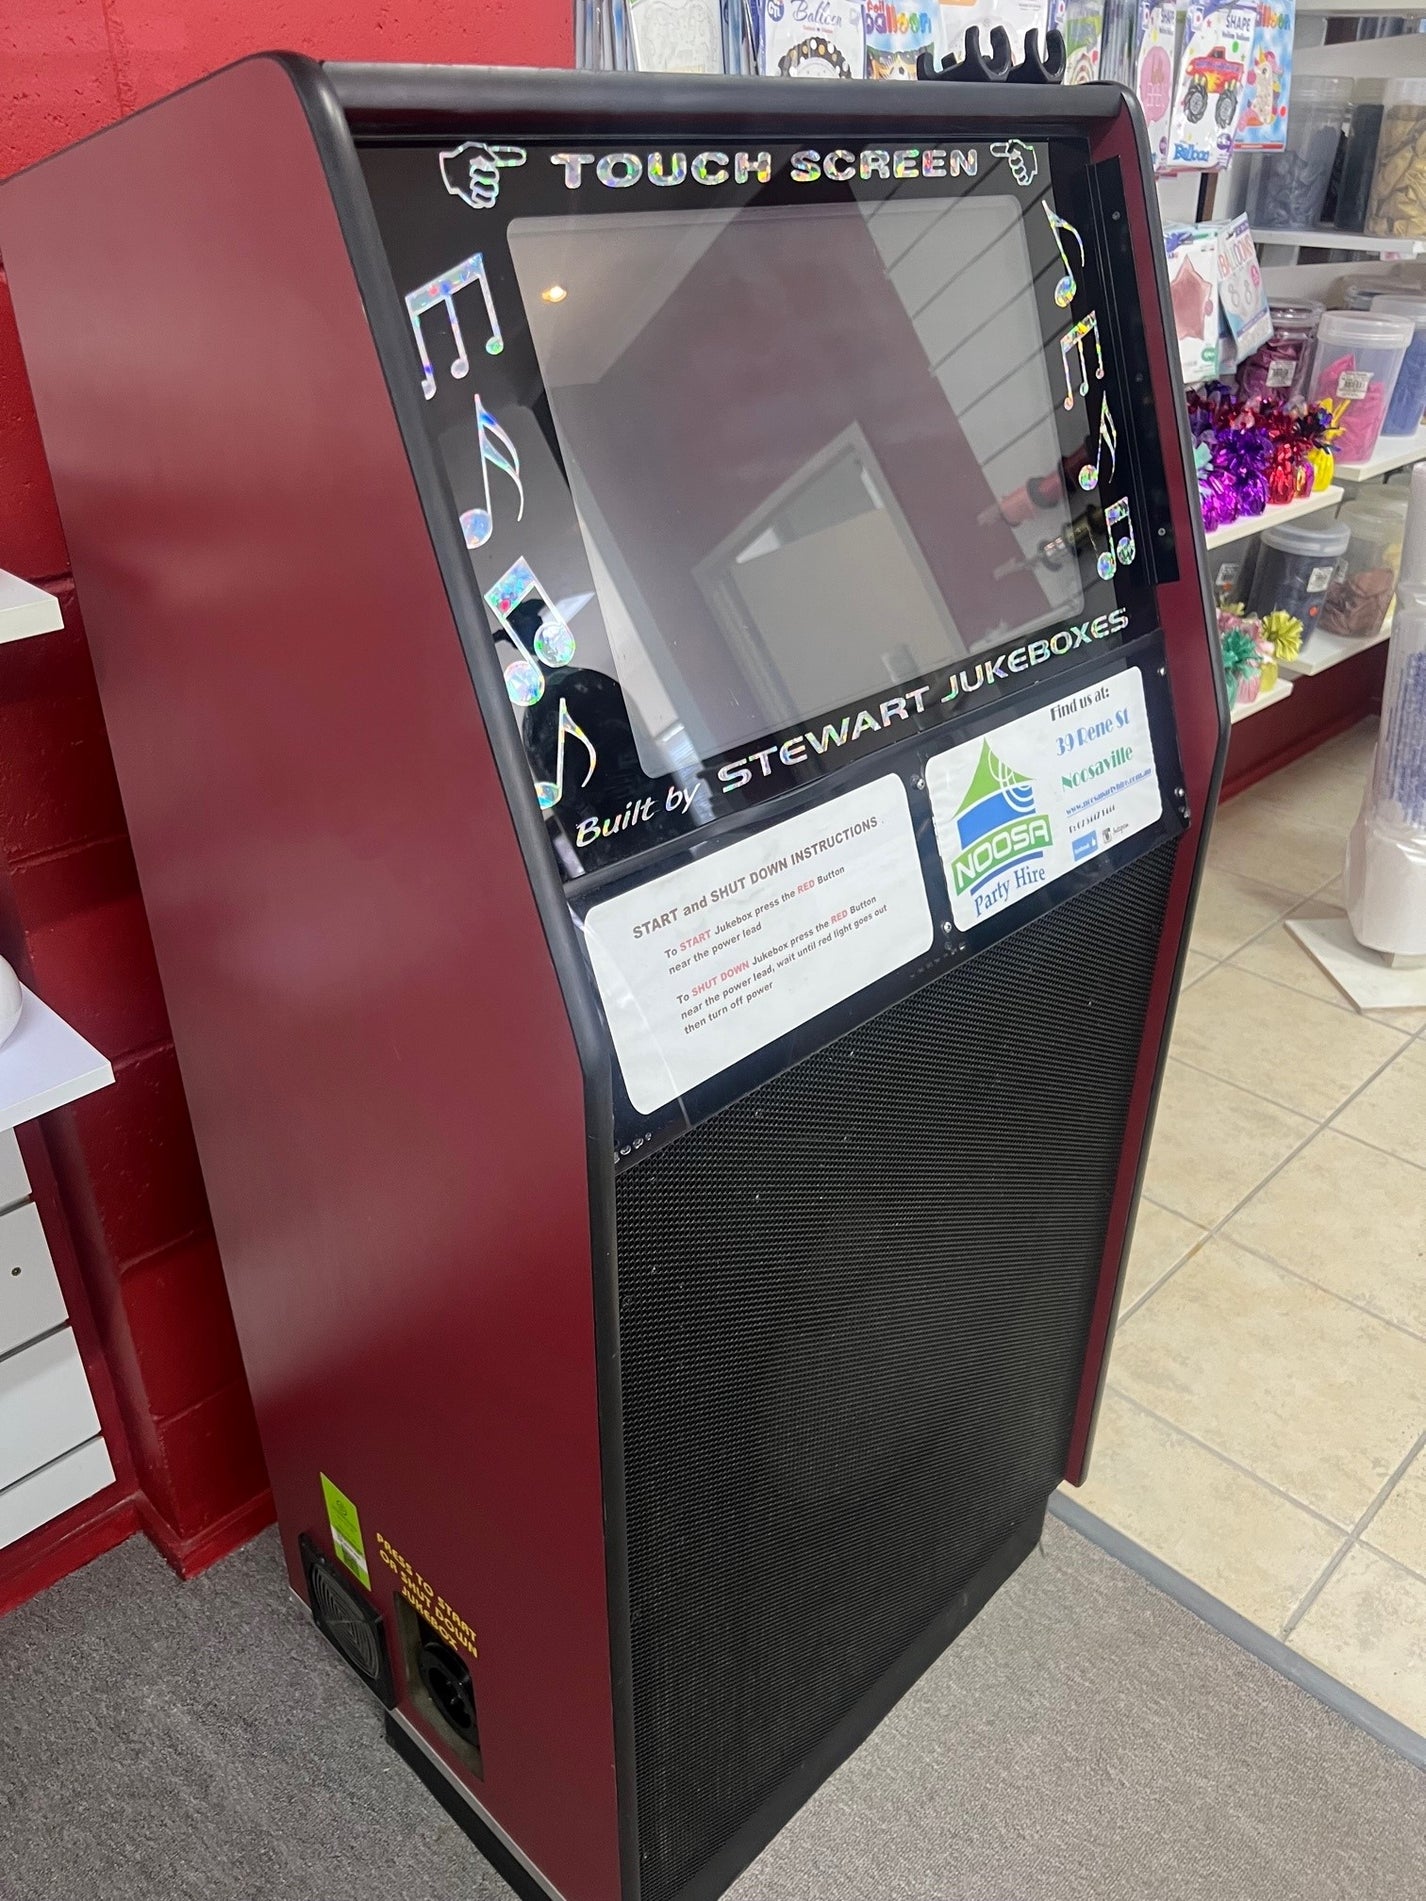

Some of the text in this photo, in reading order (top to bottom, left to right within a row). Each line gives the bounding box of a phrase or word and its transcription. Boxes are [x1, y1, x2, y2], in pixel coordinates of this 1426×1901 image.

[1226, 13, 1251, 32] SHAPE
[551, 149, 979, 189] TOUCH SCREEN
[576, 607, 1130, 849] Built by STEWART JUKEBOXES
[1050, 686, 1110, 721] Find us at:
[1056, 708, 1129, 756] 39 Rene St
[1061, 746, 1133, 792] Noosaville
[632, 816, 878, 940] START and SHUT DOWN INSTRUCTIONS
[955, 819, 1050, 888] NOOSA
[664, 865, 846, 958] To START Jukebox press the RED Button
[974, 866, 1046, 917] Party Hire
[668, 921, 763, 975] near the power lead
[676, 895, 877, 1004] To SHUT DOWN Jukebox press the RED Button
[680, 904, 888, 1020] near the power lead, wait until red light goes out
[684, 980, 774, 1035] then turn off power
[376, 1532, 477, 1642] PRESS TO START
[380, 1549, 478, 1658] OR SHUT DOWN
[402, 1586, 458, 1651] JUKEBOX
